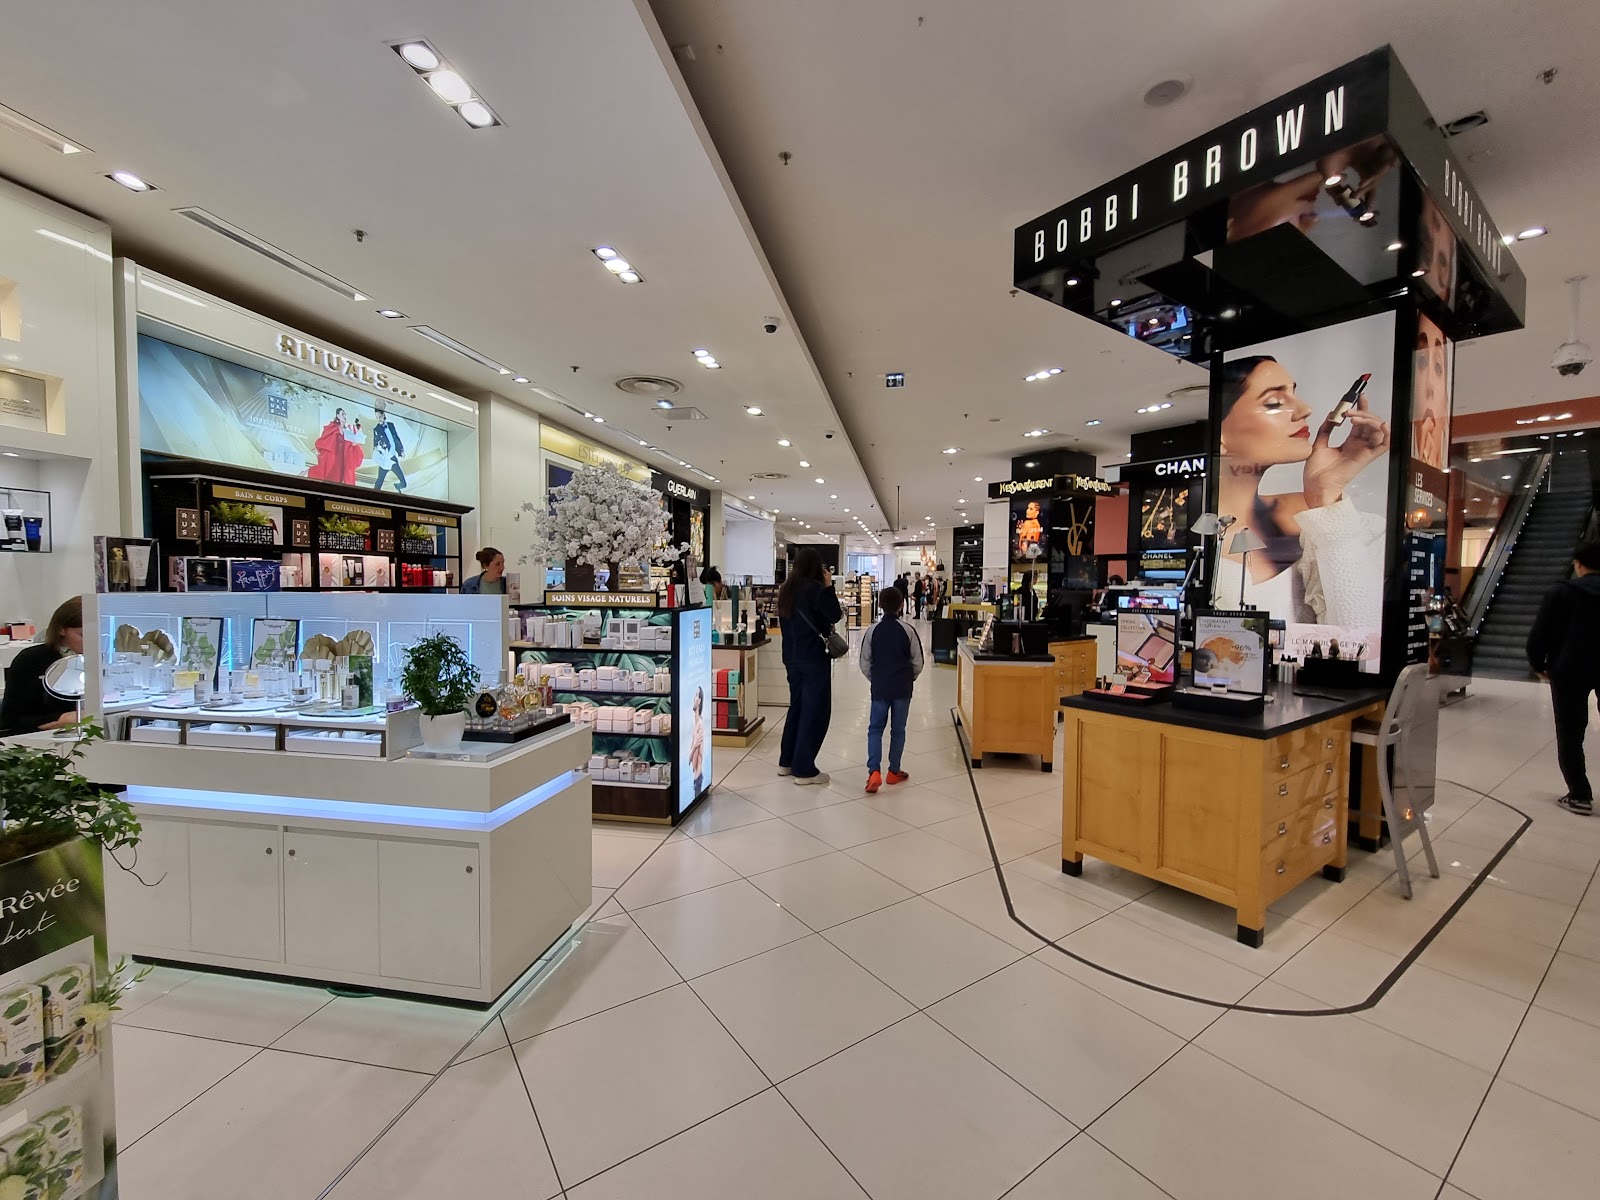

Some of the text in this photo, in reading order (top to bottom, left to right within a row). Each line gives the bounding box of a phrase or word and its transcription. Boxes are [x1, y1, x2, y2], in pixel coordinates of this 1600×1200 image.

[1034, 85, 1345, 264] BOBBI BROWN
[1444, 158, 1473, 233] BOBBI
[1415, 472, 1423, 488] LES
[235, 491, 254, 499] BAIN
[264, 495, 288, 504] CORPS
[667, 480, 697, 500] GUERLAIN
[1414, 489, 1434, 508] SERVICES
[331, 504, 360, 513] COFFRETS
[551, 594, 651, 604] SOINS VISAGE NATURELS
[0, 877, 80, 919] Rêvée
